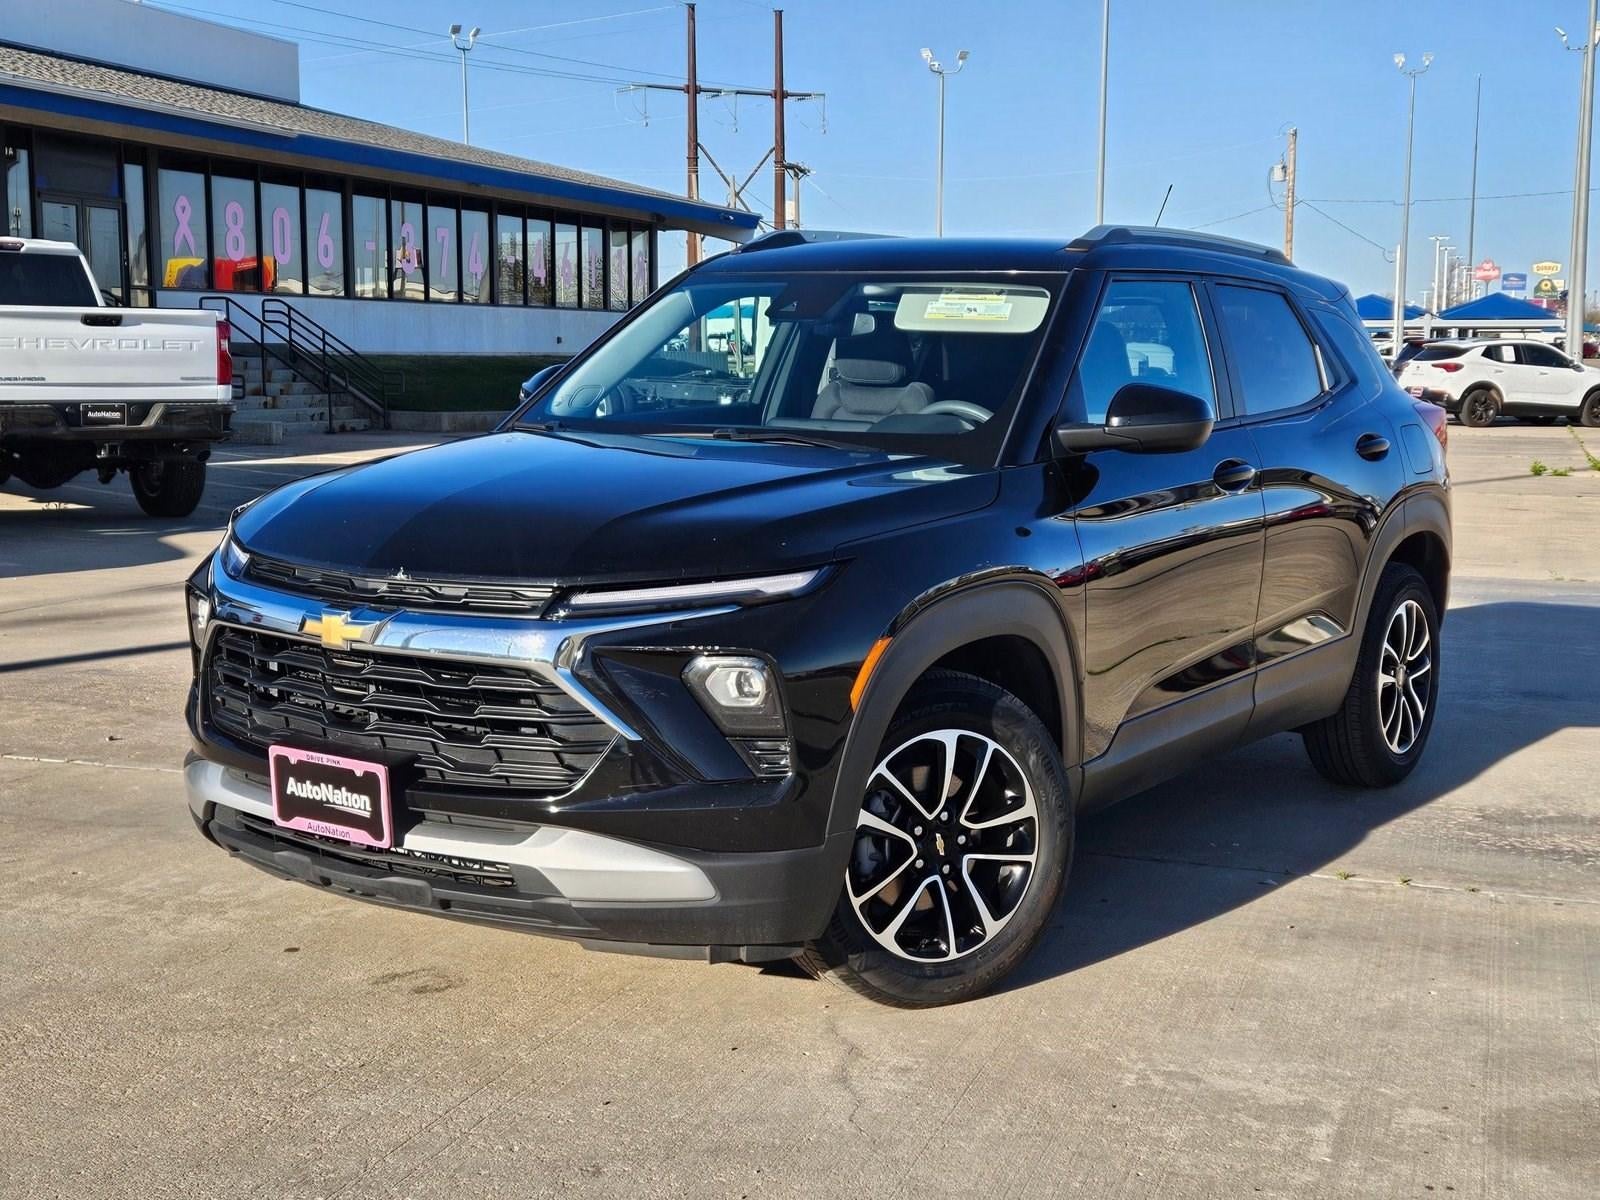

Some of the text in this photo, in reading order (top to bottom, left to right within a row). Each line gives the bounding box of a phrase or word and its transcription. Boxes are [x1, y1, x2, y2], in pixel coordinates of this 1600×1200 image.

[87, 410, 121, 418] AutoNation
[306, 754, 341, 766] DRIVE PINK
[286, 777, 372, 811] AutoNation
[306, 822, 351, 839] AutoNation
